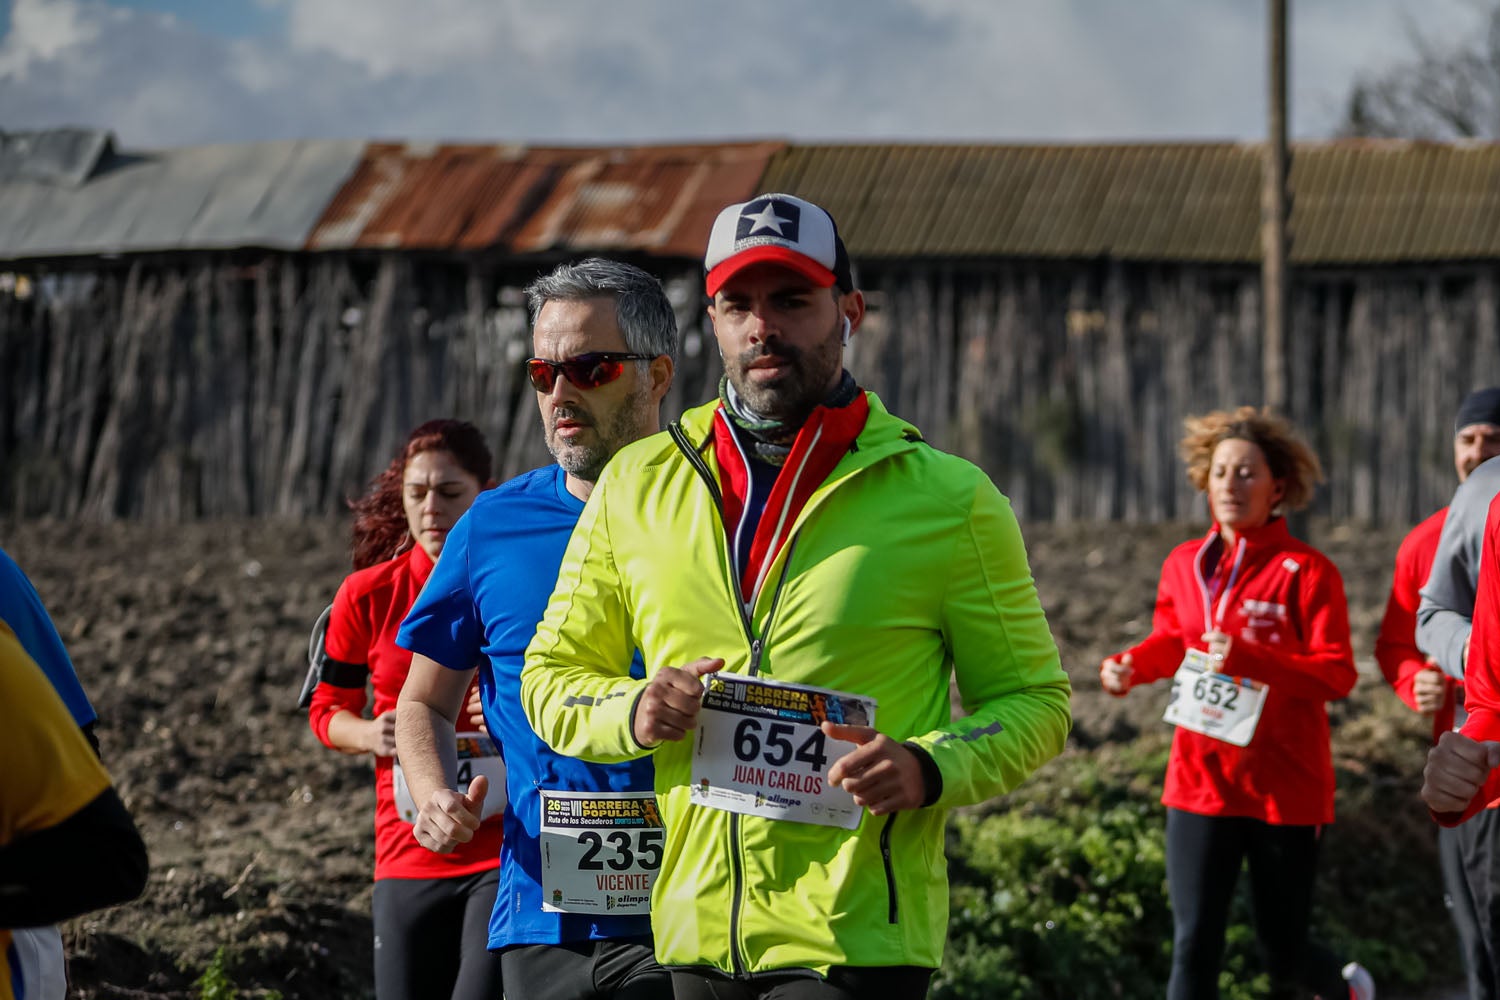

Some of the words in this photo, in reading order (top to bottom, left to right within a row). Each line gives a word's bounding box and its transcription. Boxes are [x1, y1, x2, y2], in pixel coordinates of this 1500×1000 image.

[709, 679, 725, 692] 26
[746, 684, 810, 701] CARRERA
[1193, 677, 1240, 711] 652
[745, 694, 809, 711] POPULAR
[733, 718, 827, 772] 654
[732, 764, 766, 787] JUAN
[768, 769, 823, 795] CARLOS
[547, 800, 561, 811] 26
[570, 800, 582, 817] VII
[582, 800, 639, 810] CARRERA
[767, 794, 802, 807] olimpo
[547, 815, 561, 824] Ruta
[561, 816, 570, 824] de
[580, 817, 614, 825] Secaderos
[583, 809, 640, 817] POPULAR
[577, 831, 663, 871] 235
[596, 873, 650, 891] VICENTE
[617, 894, 649, 904] olimpo
